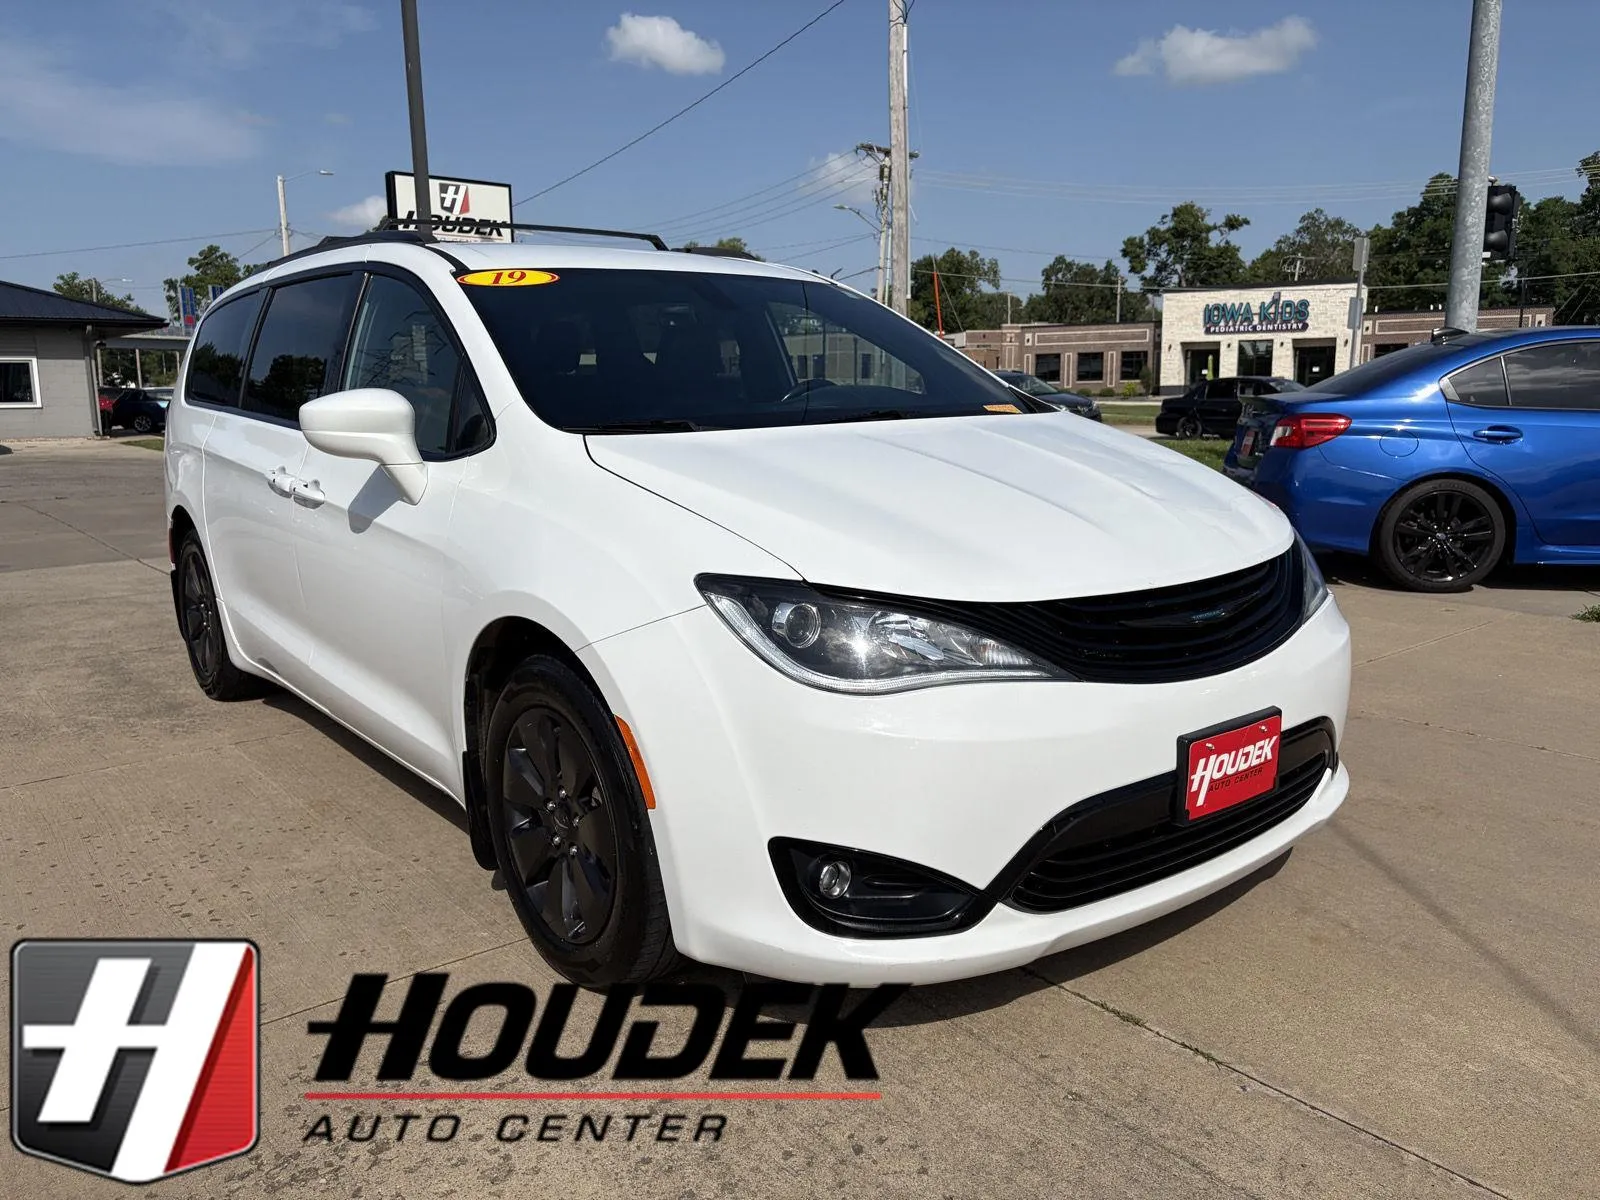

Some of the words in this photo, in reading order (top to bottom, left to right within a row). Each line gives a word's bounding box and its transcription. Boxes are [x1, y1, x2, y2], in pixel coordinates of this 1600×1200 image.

[491, 271, 527, 285] 19
[1204, 302, 1253, 323] IOWA
[1259, 293, 1310, 322] KIDS
[1210, 325, 1253, 333] PEDIATRIC
[1256, 322, 1303, 331] DENTISTRY
[1190, 735, 1279, 807] HOUDEK
[1209, 779, 1231, 793] AUTO
[1234, 767, 1263, 784] CENTER
